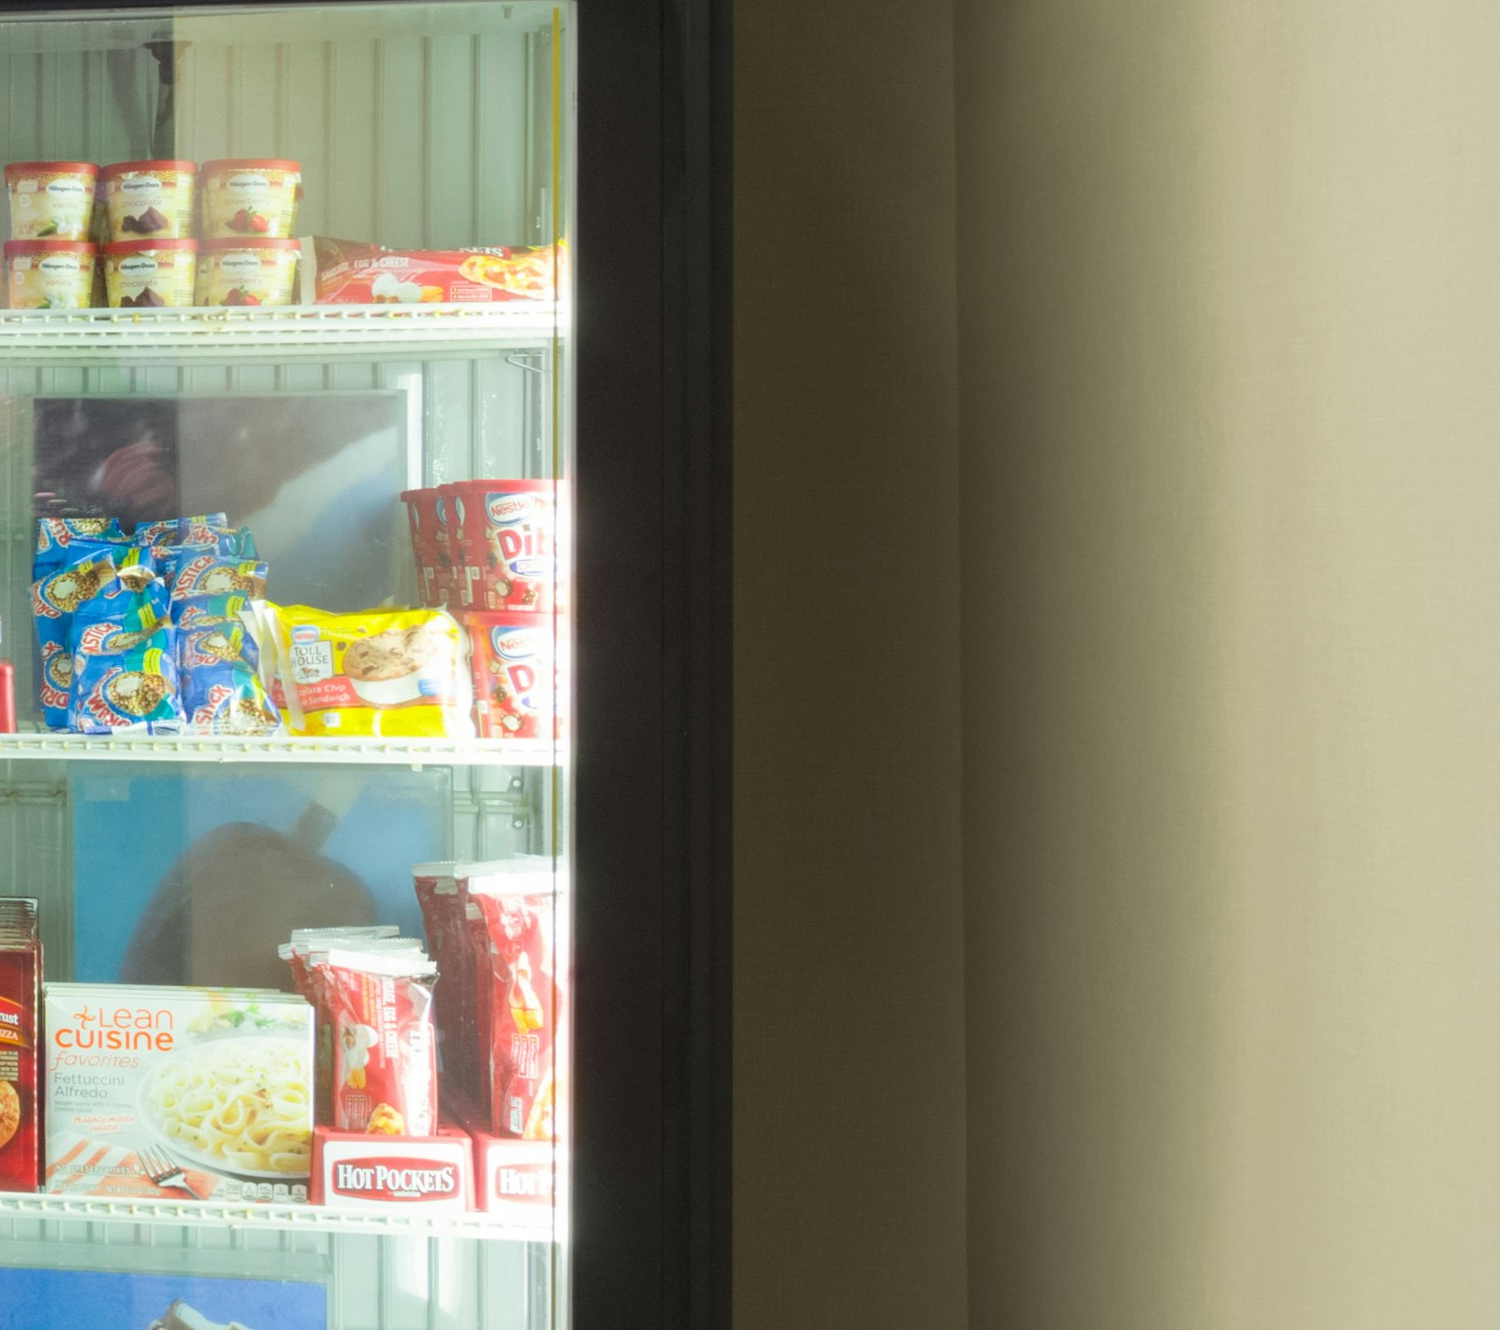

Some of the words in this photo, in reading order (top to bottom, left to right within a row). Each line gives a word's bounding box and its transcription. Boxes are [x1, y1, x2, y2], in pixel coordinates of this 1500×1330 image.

[293, 646, 321, 657] TOLL
[324, 683, 346, 693] Chip
[49, 1051, 139, 1071] favorites
[54, 1072, 125, 1087] Fettuccini
[54, 1086, 108, 1099] Alfredo
[337, 1164, 375, 1189] HOT
[375, 1164, 454, 1193] POCKETS
